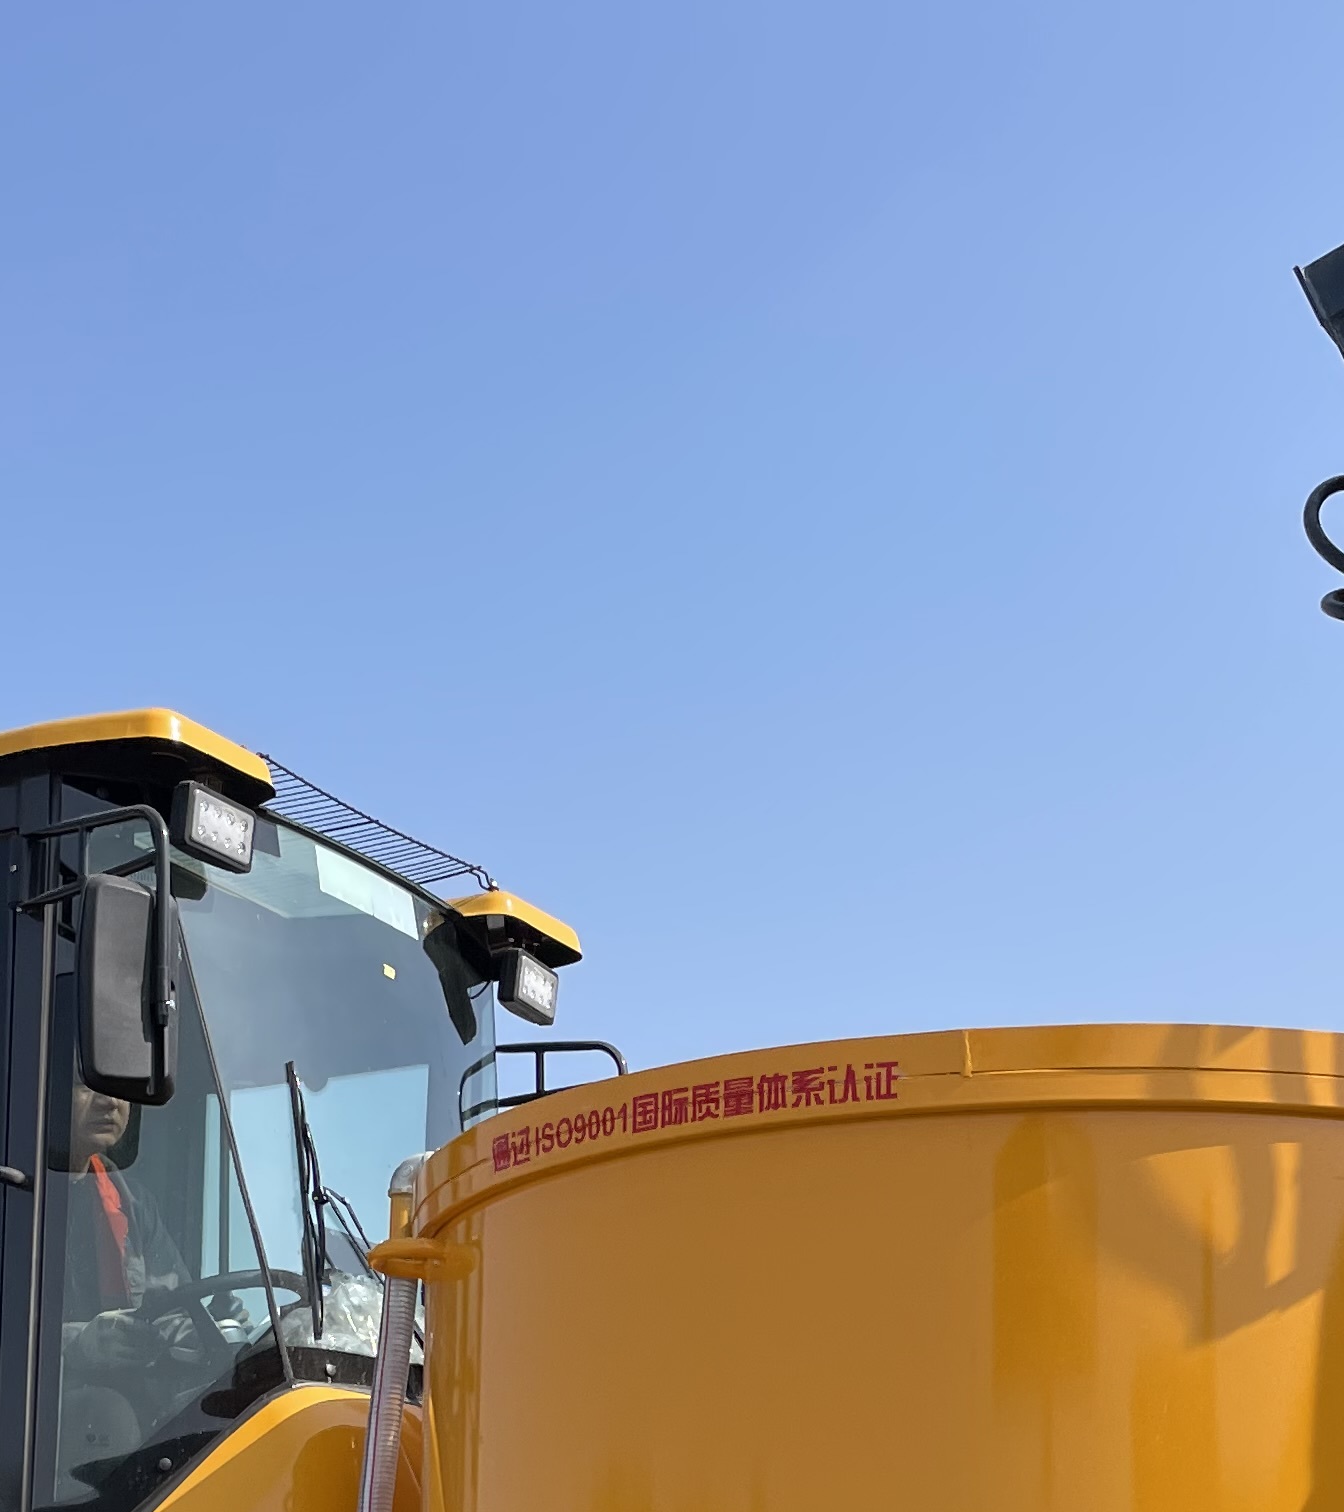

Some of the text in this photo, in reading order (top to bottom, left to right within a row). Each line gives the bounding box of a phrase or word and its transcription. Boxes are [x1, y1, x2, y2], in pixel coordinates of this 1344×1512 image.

[492, 1061, 900, 1174] 通过ISO9001国际质量体系认证
